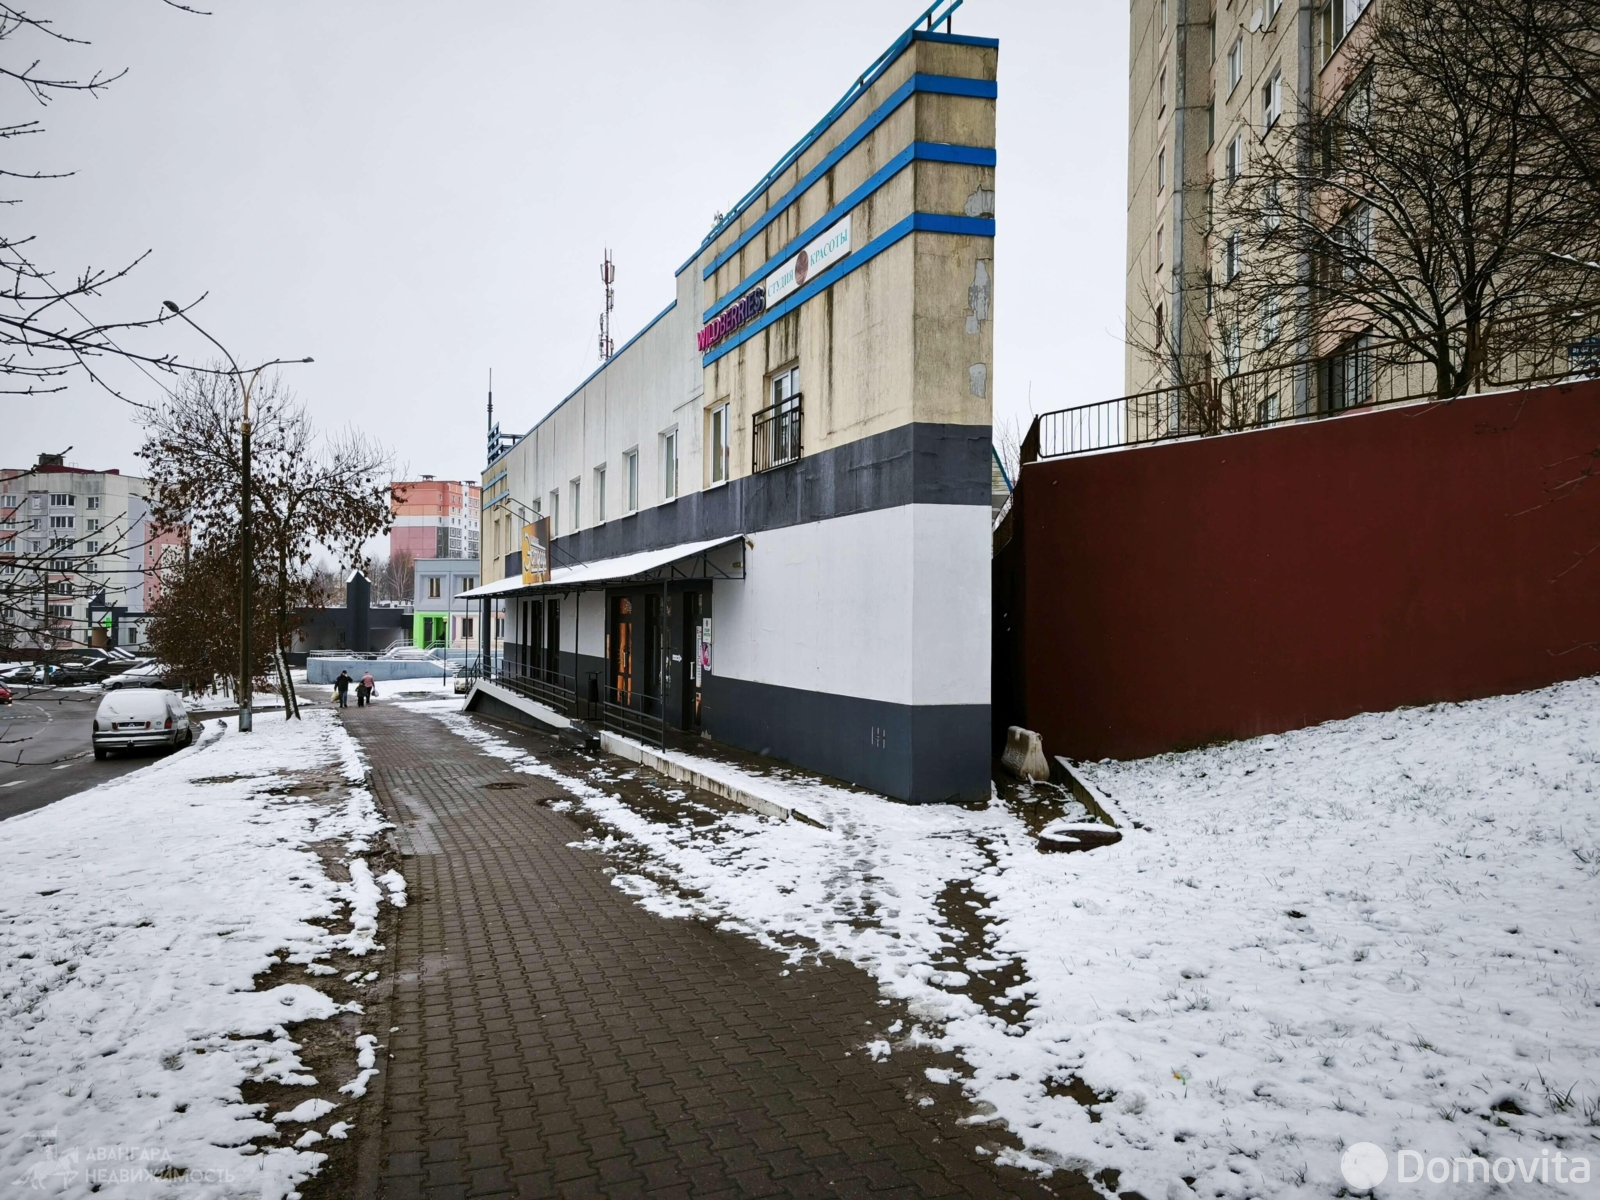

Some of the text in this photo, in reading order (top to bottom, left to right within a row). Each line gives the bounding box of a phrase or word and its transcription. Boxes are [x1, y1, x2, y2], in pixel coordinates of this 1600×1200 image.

[767, 229, 848, 297] СТУДИЯ КРАСОТЫ
[697, 285, 766, 352] WILDBERRIES
